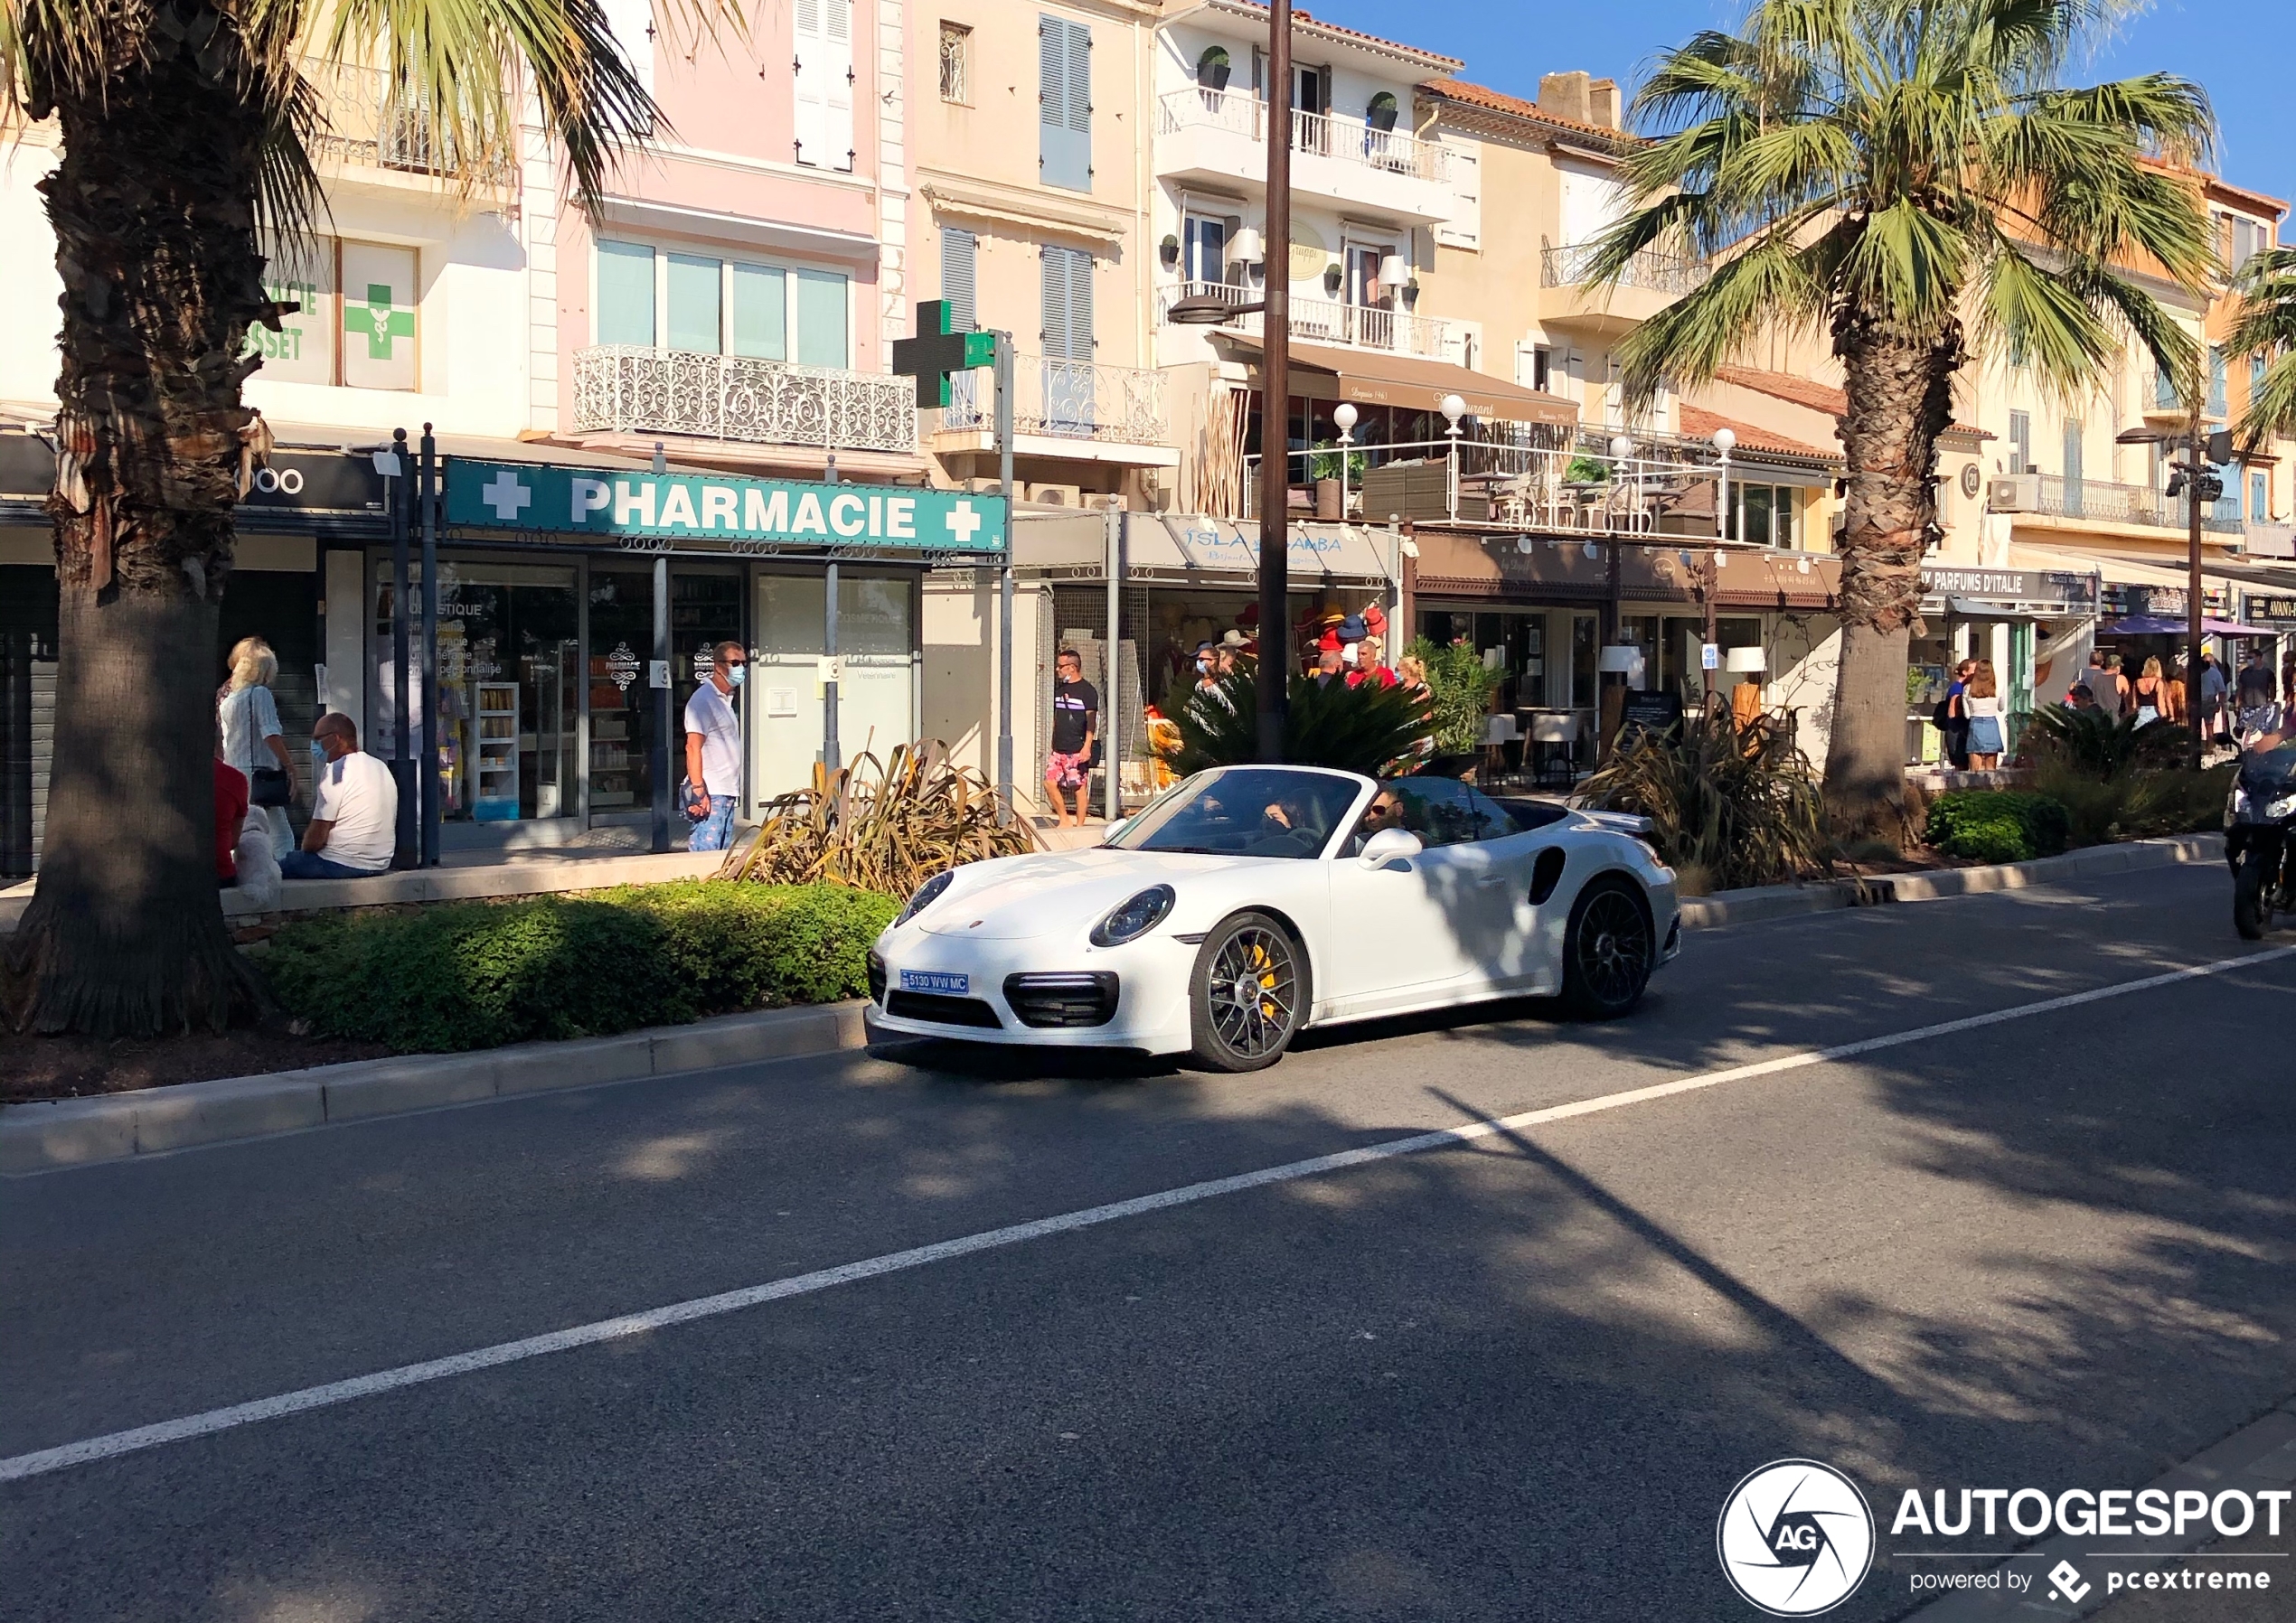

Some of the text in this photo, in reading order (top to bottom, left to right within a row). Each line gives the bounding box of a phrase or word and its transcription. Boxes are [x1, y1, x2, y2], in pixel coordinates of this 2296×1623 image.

[571, 478, 916, 539] PHARMACIE
[1934, 571, 1981, 592] PARFUMS
[1983, 574, 2023, 594] D'ITALIE
[2147, 596, 2183, 609] SHOES
[605, 661, 641, 671] PHARMACIE
[909, 974, 965, 990] 5130 WW MC
